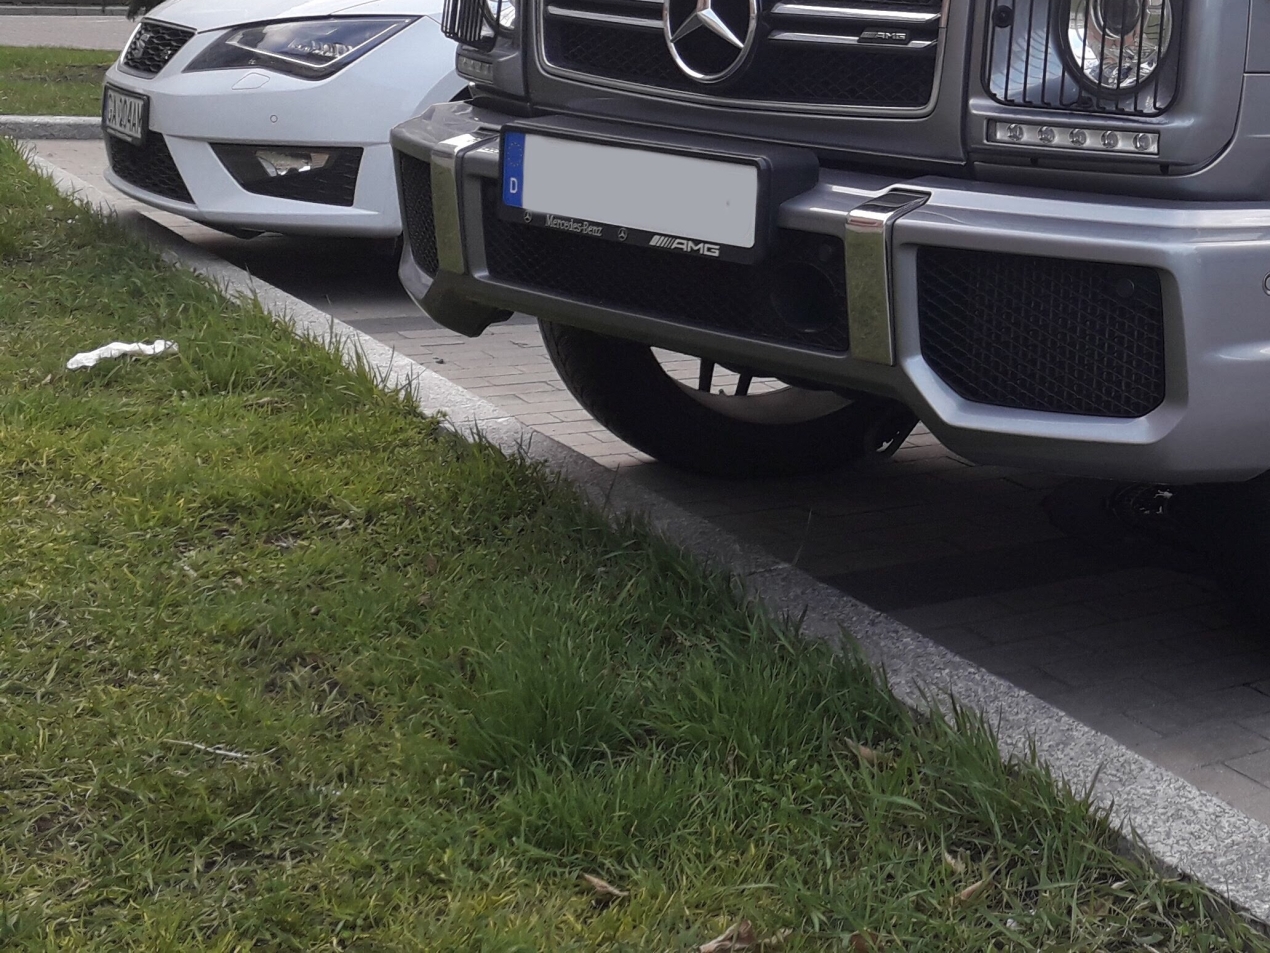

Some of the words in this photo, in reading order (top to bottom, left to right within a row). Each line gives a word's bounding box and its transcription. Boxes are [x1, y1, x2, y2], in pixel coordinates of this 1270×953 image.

[875, 31, 906, 40] AMG
[509, 177, 518, 194] D
[545, 214, 603, 237] Mercedes-Benz
[671, 238, 721, 257] AMG
